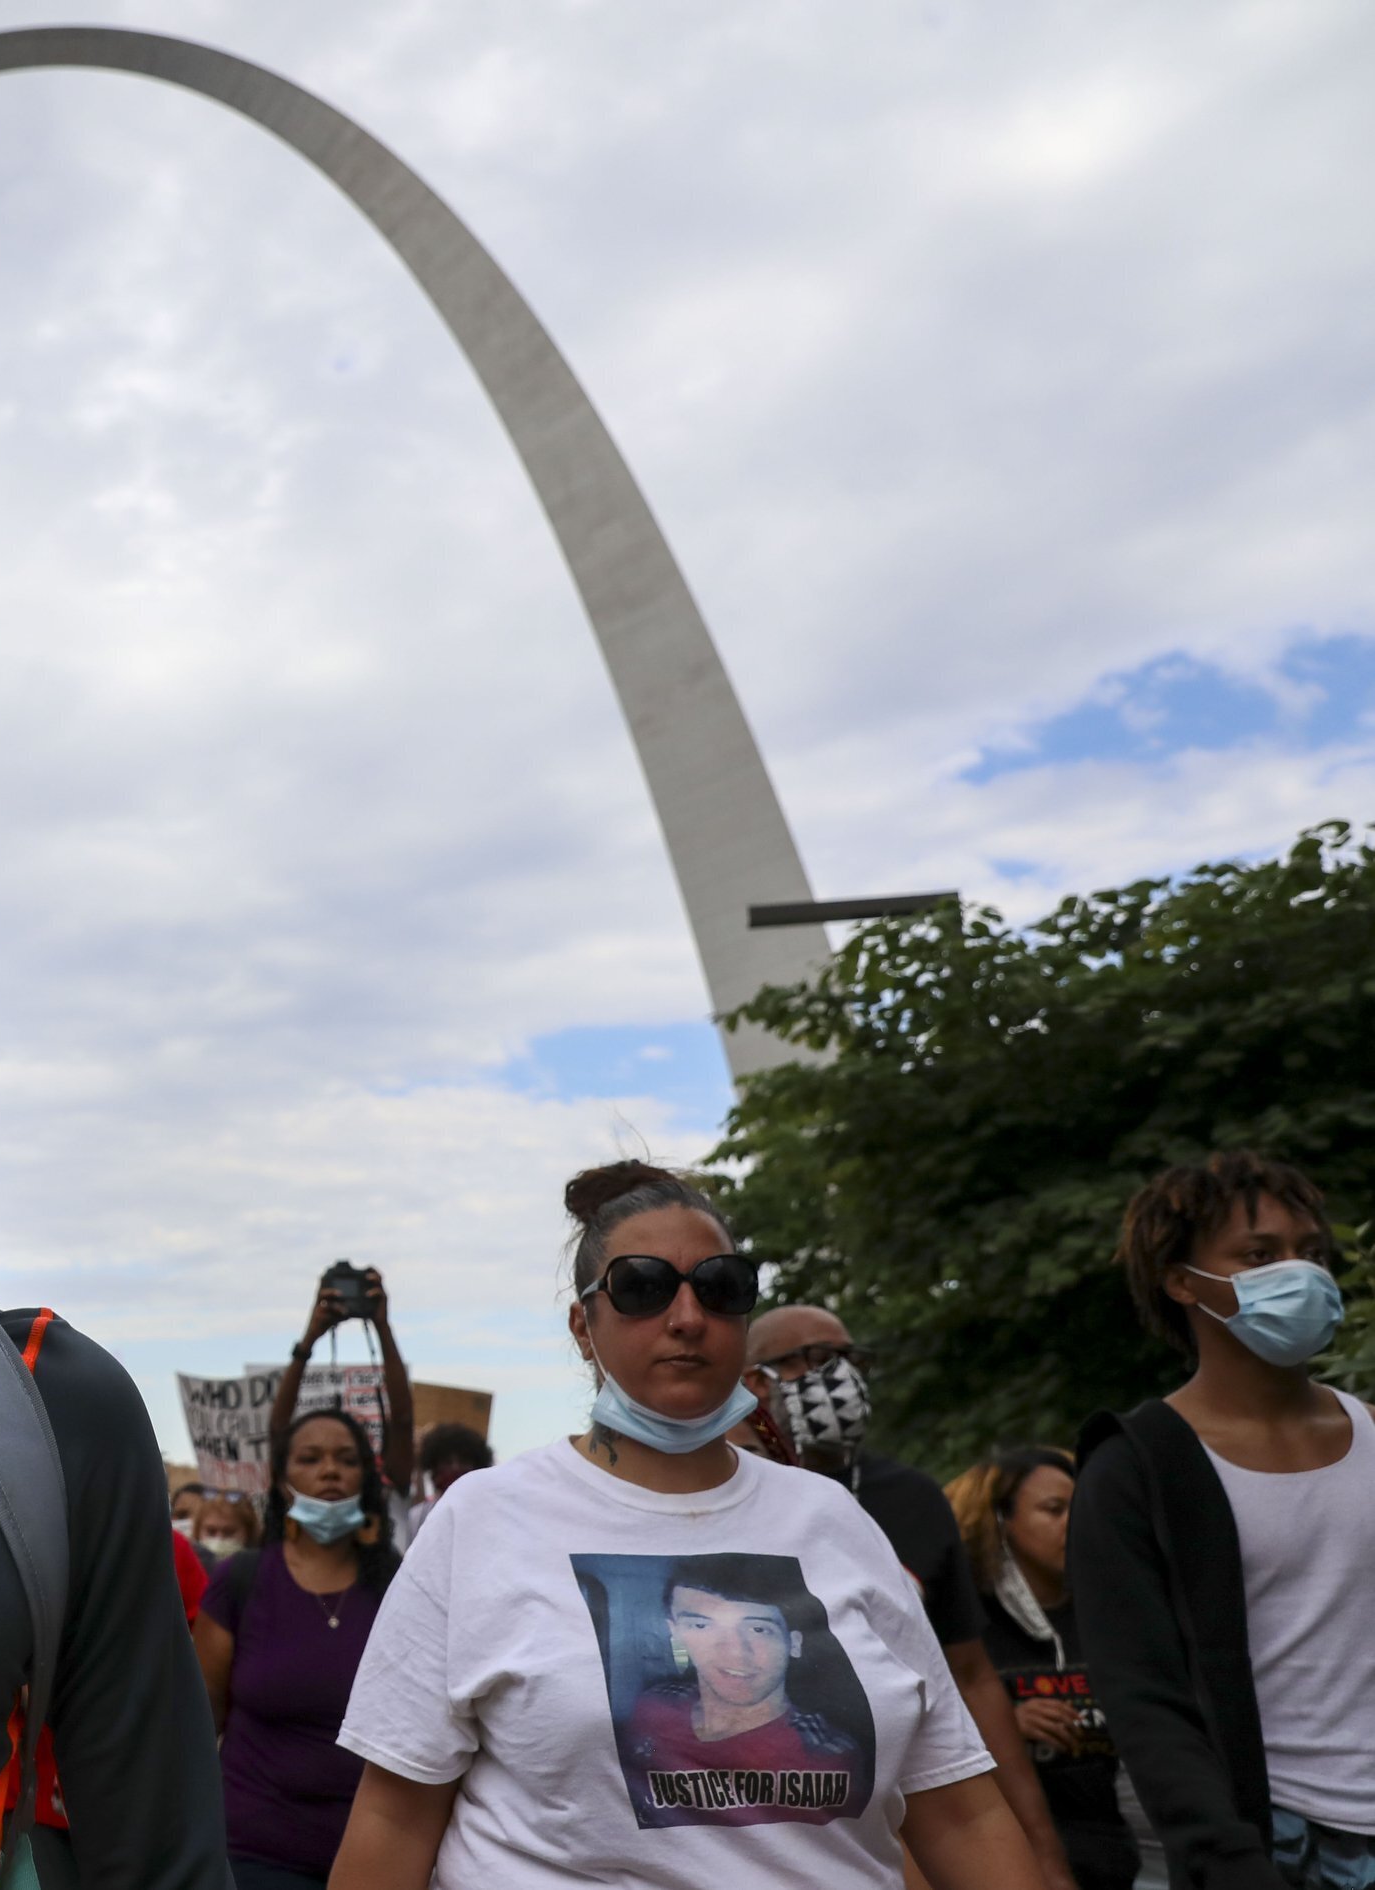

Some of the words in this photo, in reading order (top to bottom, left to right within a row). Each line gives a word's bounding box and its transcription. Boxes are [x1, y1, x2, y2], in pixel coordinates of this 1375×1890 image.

[182, 1377, 242, 1410] WHO
[1016, 1674, 1090, 1696] LOVE
[649, 1770, 734, 1810] JUSTICE
[735, 1770, 775, 1807] FOR
[778, 1771, 849, 1810] ISAIAH
